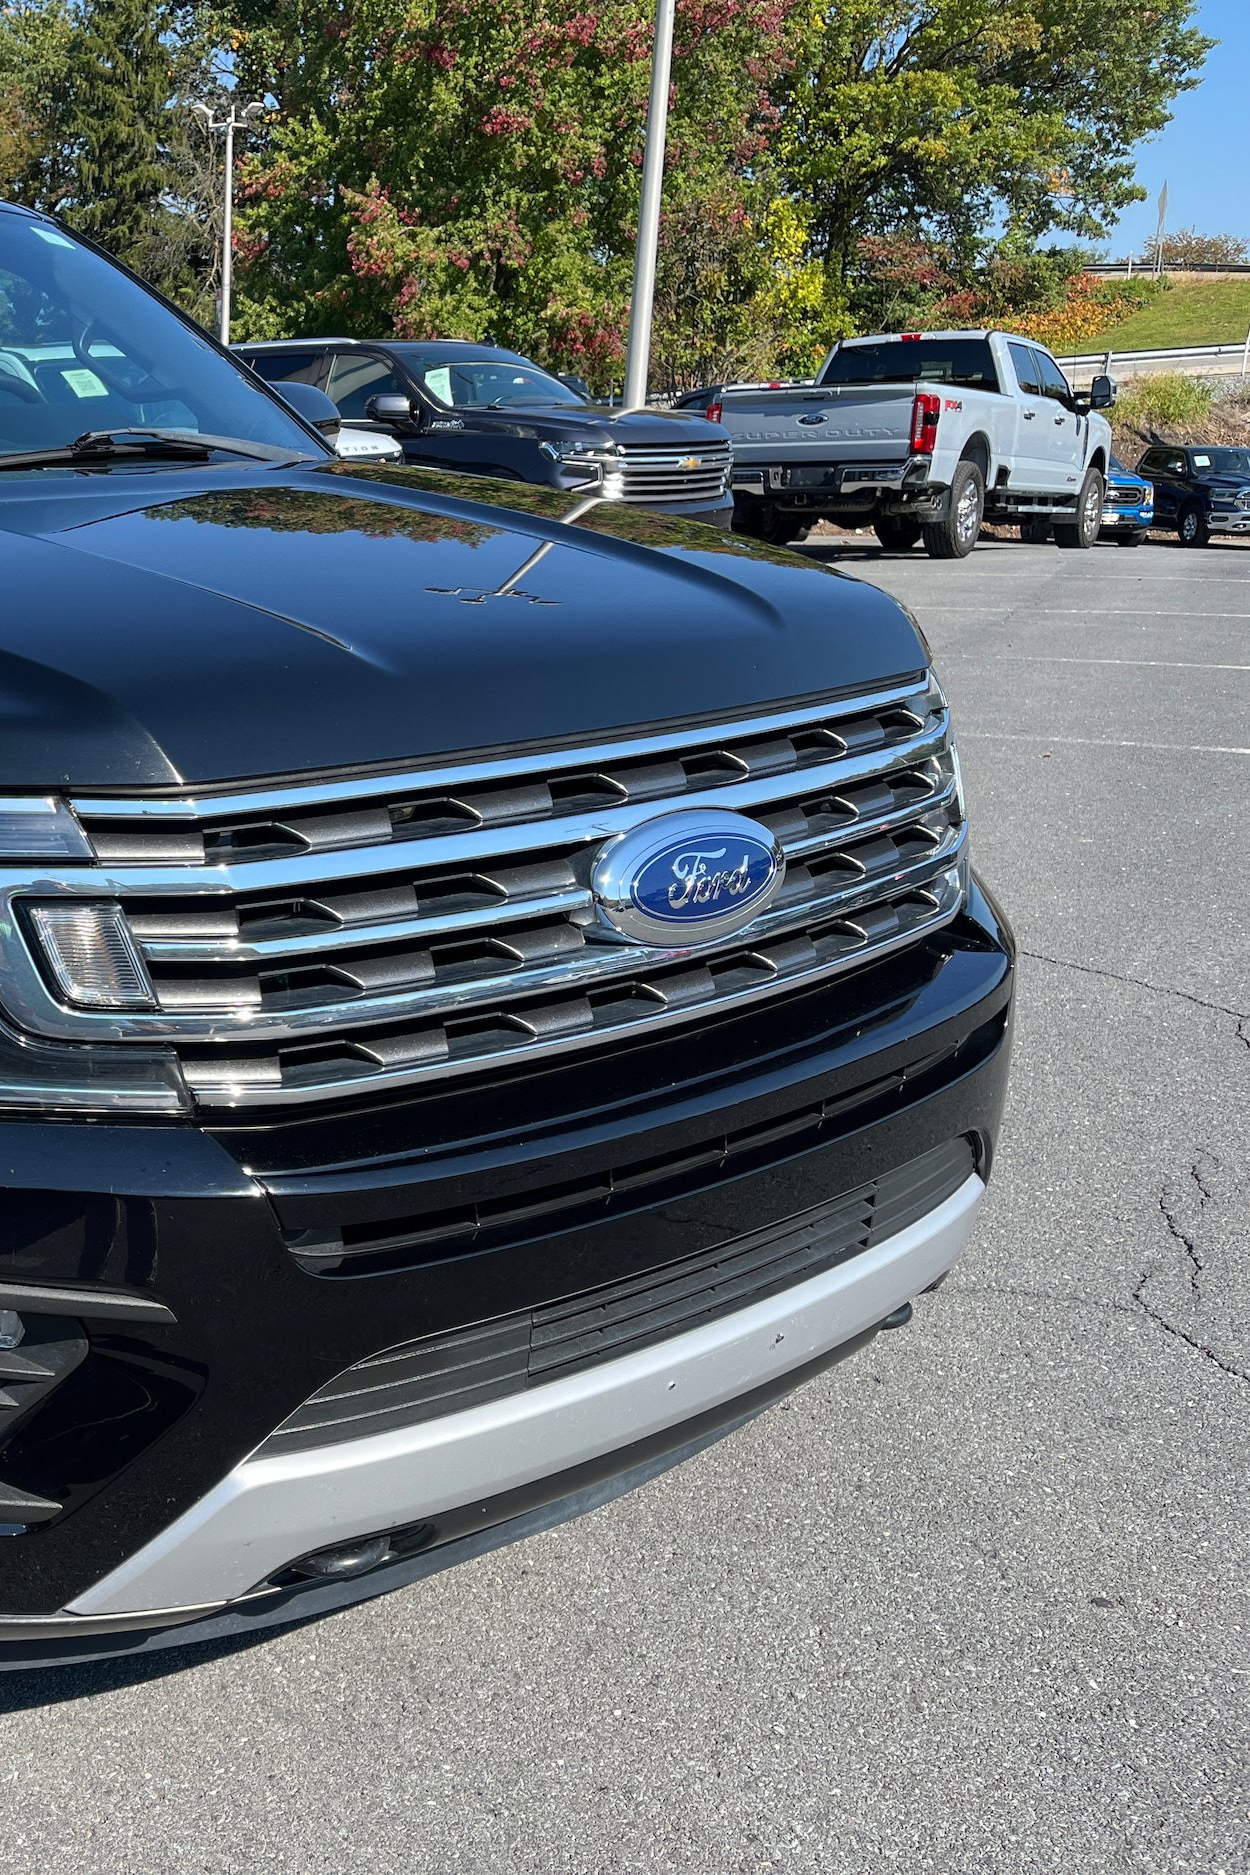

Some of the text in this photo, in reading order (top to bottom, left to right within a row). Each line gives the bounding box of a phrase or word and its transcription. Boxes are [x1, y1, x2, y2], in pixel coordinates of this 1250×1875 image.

[944, 399, 963, 412] FX4
[732, 426, 900, 441] SUPER DUTY
[667, 846, 753, 910] Ford
